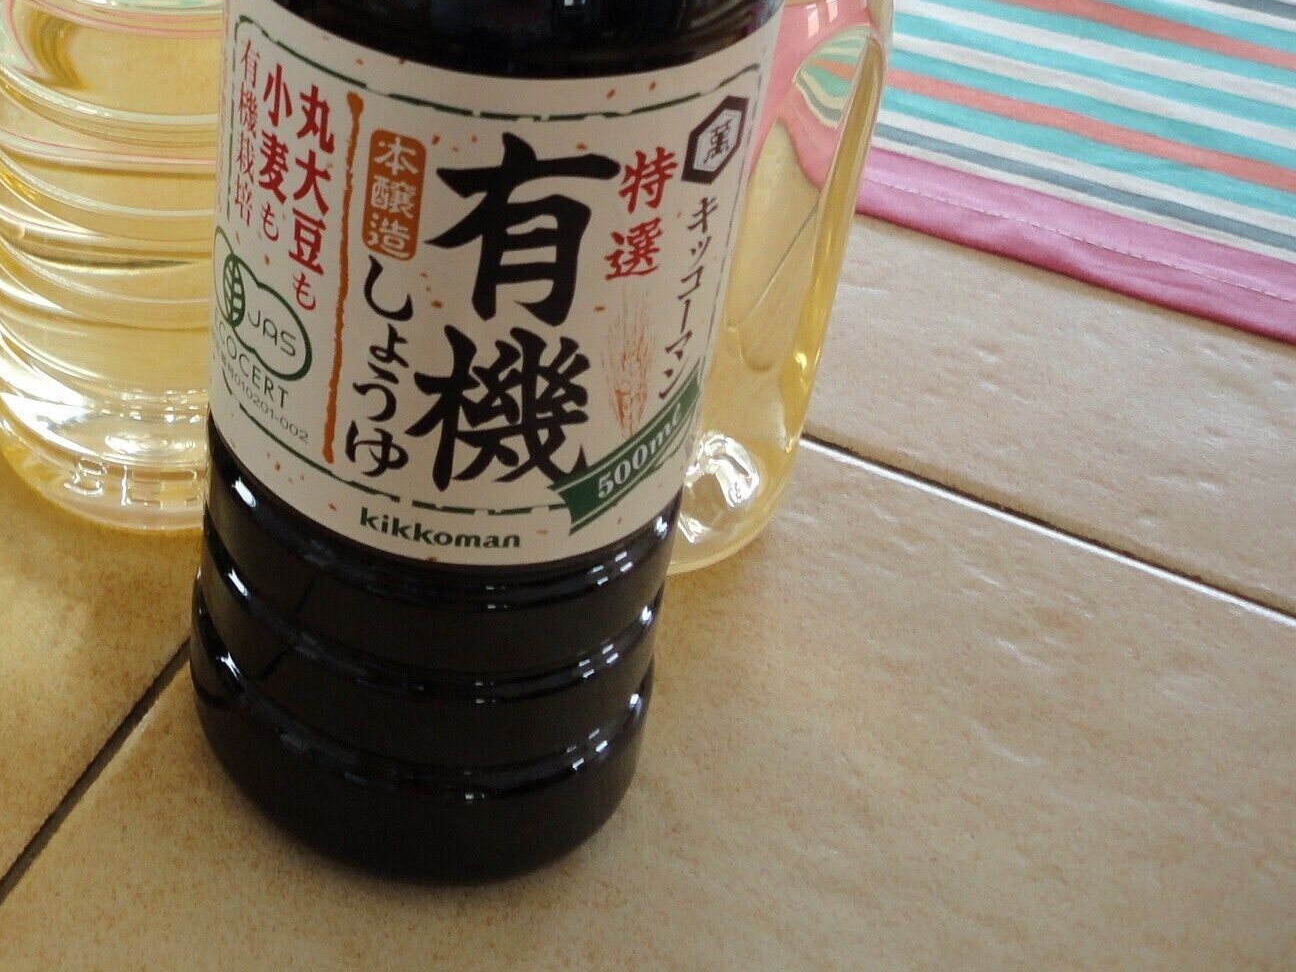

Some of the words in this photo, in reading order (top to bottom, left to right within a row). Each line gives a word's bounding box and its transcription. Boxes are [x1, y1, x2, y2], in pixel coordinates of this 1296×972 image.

[258, 62, 294, 244] 小麦も
[287, 84, 336, 312] 丸大豆も
[367, 134, 422, 258] 本醸造
[604, 145, 679, 282] 特選
[247, 309, 297, 358] JAS
[345, 254, 414, 478] しょうゆ
[404, 131, 624, 492] 有機
[658, 195, 719, 401] キッコーマン
[359, 506, 521, 549] kikkoman
[597, 402, 682, 499] 500ml
